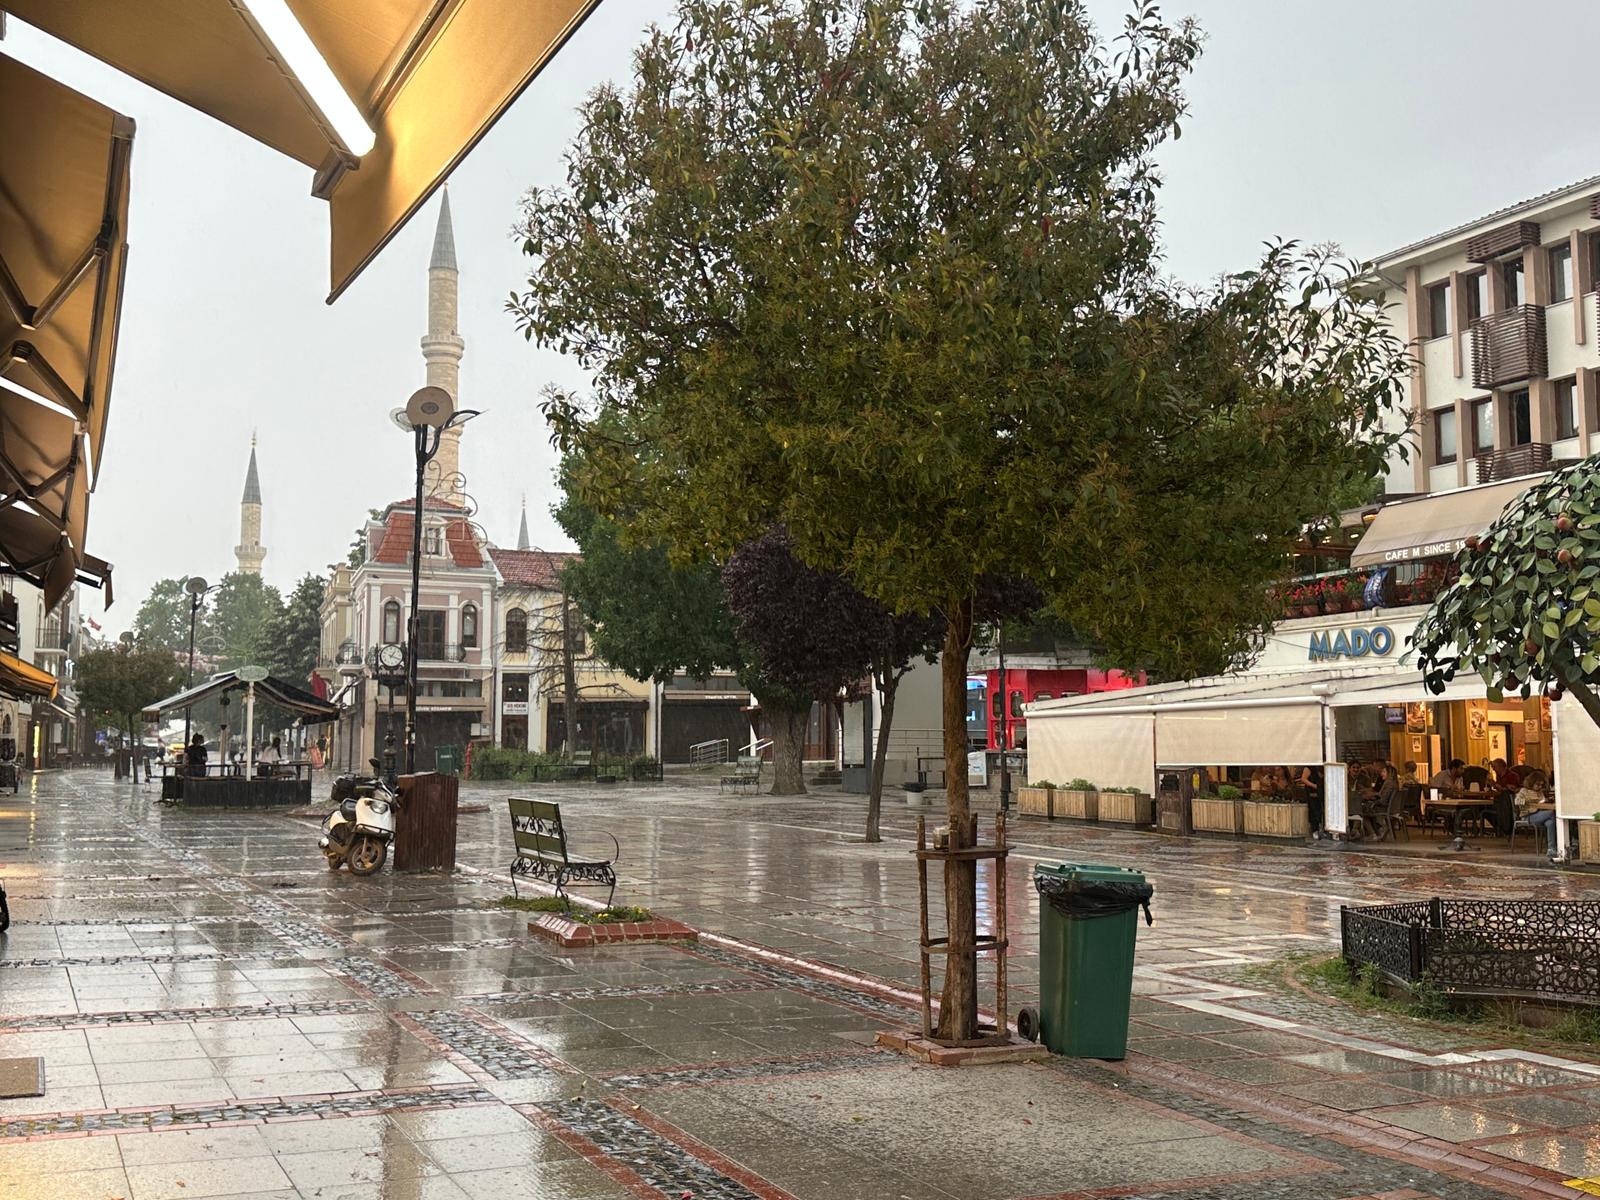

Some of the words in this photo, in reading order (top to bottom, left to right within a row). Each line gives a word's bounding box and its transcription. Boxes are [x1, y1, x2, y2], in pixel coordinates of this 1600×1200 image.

[1385, 549, 1409, 561] CAFE
[1412, 547, 1420, 558] M
[1424, 542, 1451, 556] SINCE
[1308, 625, 1395, 661] MADO
